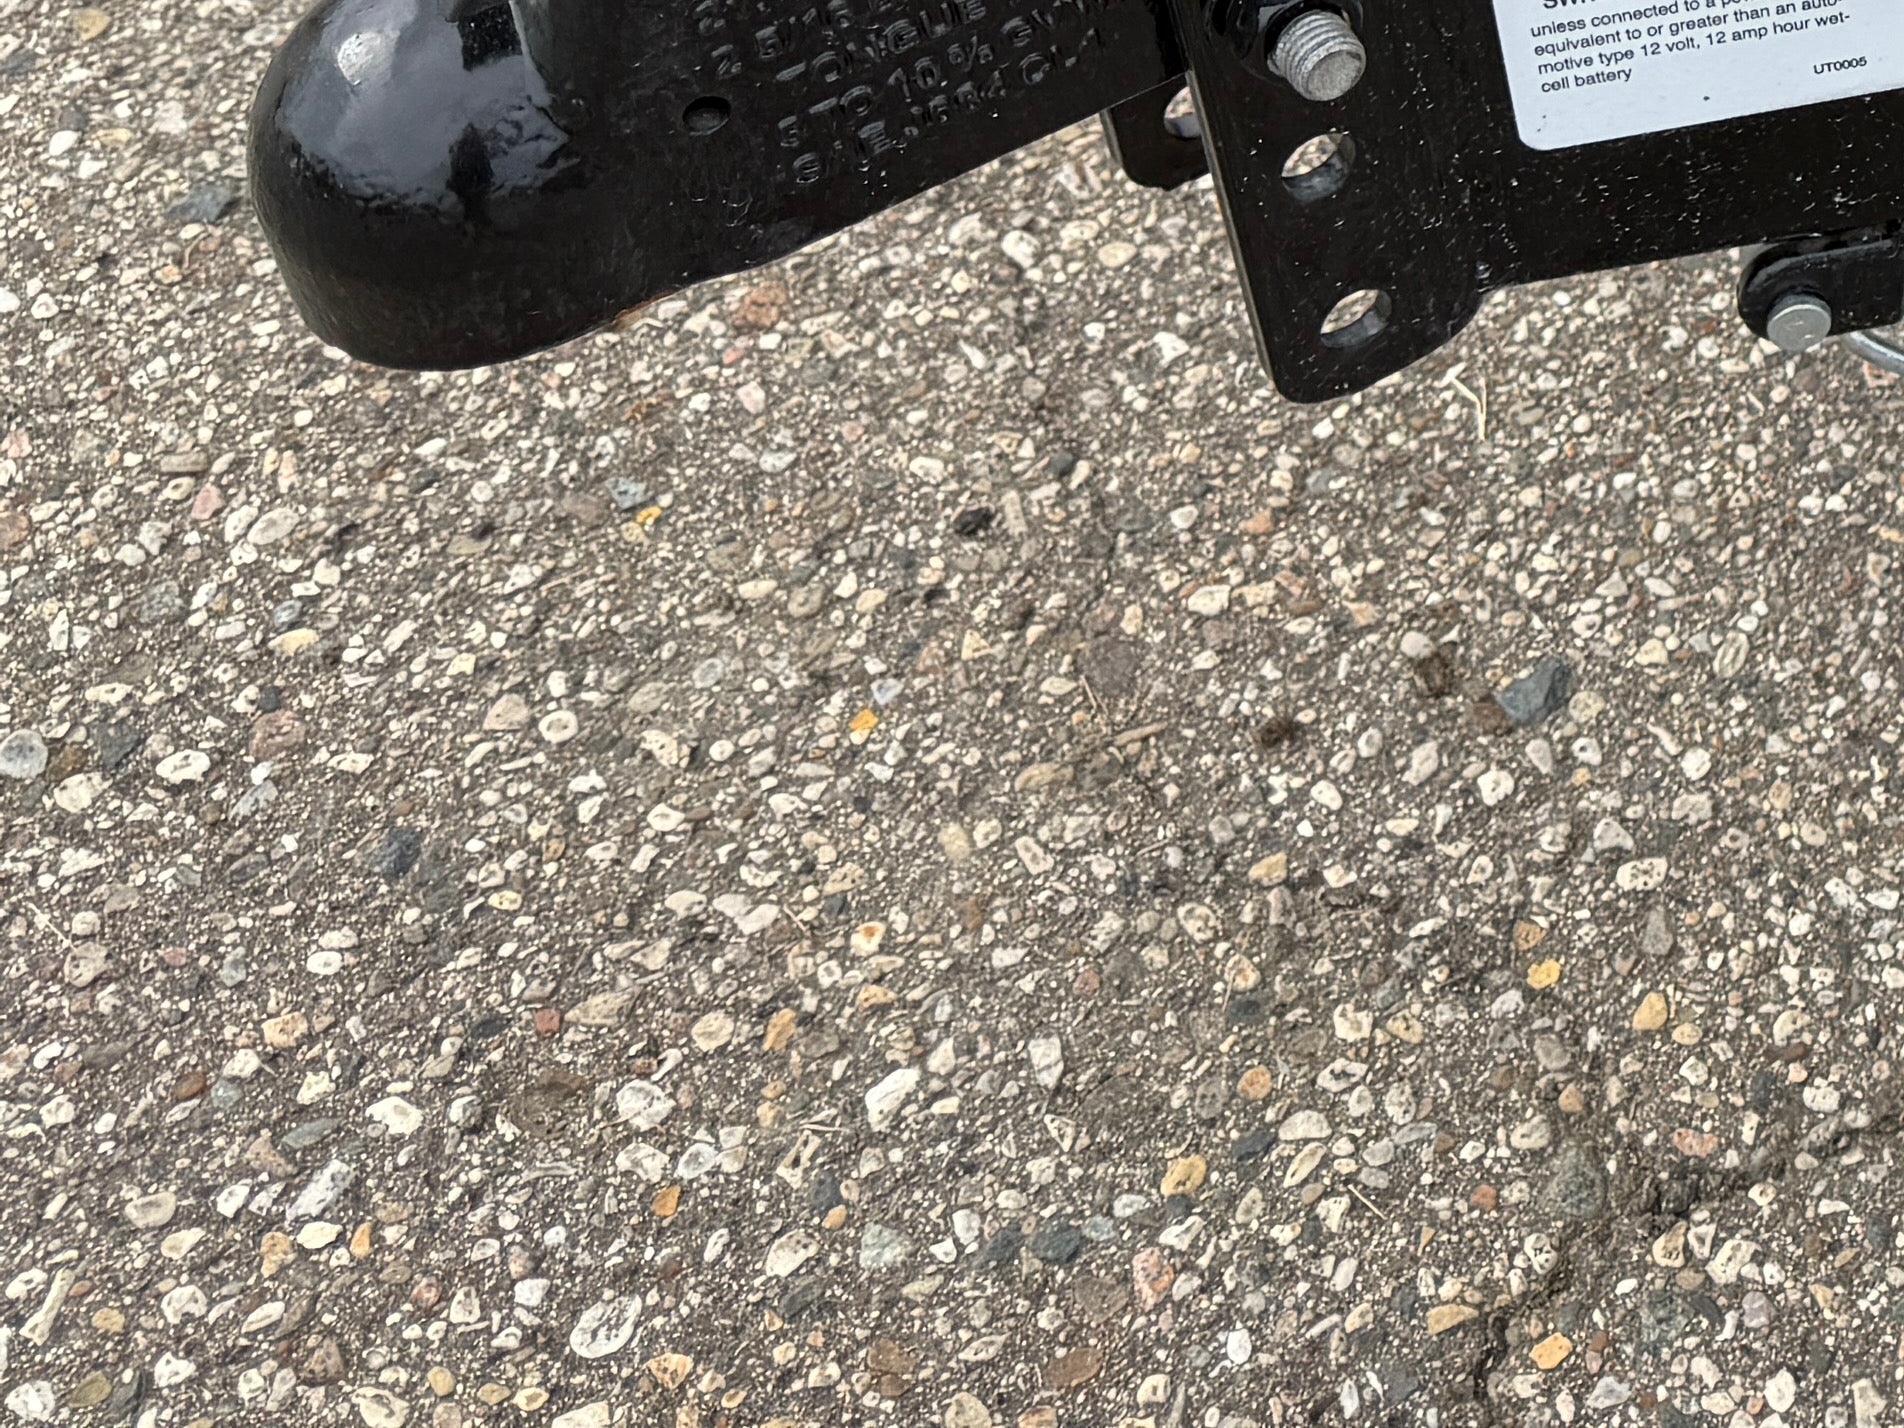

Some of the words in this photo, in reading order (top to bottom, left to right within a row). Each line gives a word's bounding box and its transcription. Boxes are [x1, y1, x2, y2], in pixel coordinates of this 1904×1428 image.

[1531, 19, 1587, 37] unless
[1591, 0, 1680, 27] connected
[1534, 30, 1622, 59] equivalent
[1626, 28, 1642, 42] to
[1647, 26, 1664, 38] or
[1669, 15, 1729, 39] greater
[1733, 8, 1771, 24] than
[1776, 5, 1796, 17] an
[1538, 55, 1594, 75] motive
[1599, 49, 1635, 67] type
[1640, 41, 1661, 58] 12
[1665, 37, 1700, 54] volt,
[1706, 30, 1727, 47] 12
[1732, 28, 1768, 43] amp
[1773, 21, 1810, 36] hour
[1815, 12, 1850, 29] wet-
[1541, 74, 1570, 93] cell
[1574, 68, 1632, 87] battery
[1813, 57, 1868, 75] UT0005
